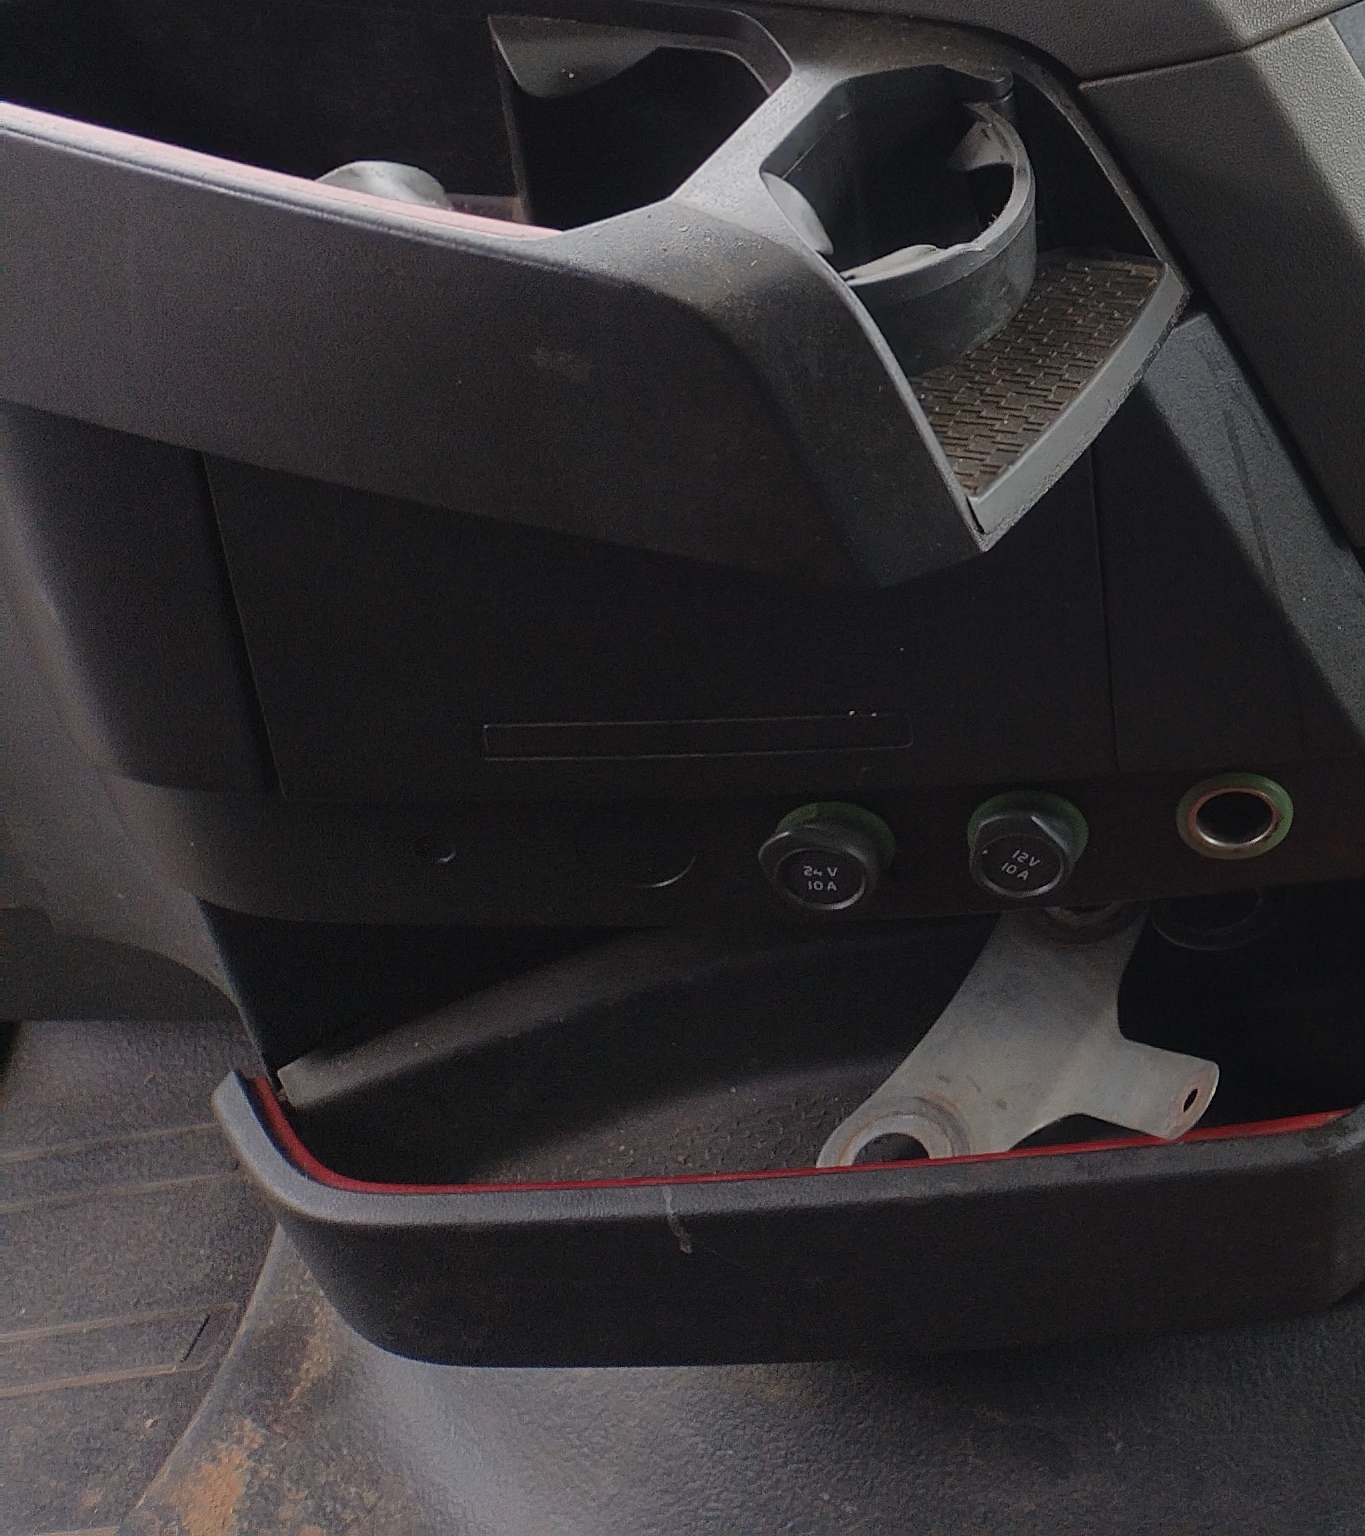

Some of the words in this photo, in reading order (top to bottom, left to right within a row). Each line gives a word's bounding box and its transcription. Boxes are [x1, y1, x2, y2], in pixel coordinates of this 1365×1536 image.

[826, 866, 839, 878] V
[1001, 861, 1017, 875] 10
[1017, 868, 1031, 882] A
[807, 880, 823, 892] 10
[826, 881, 838, 892] A
